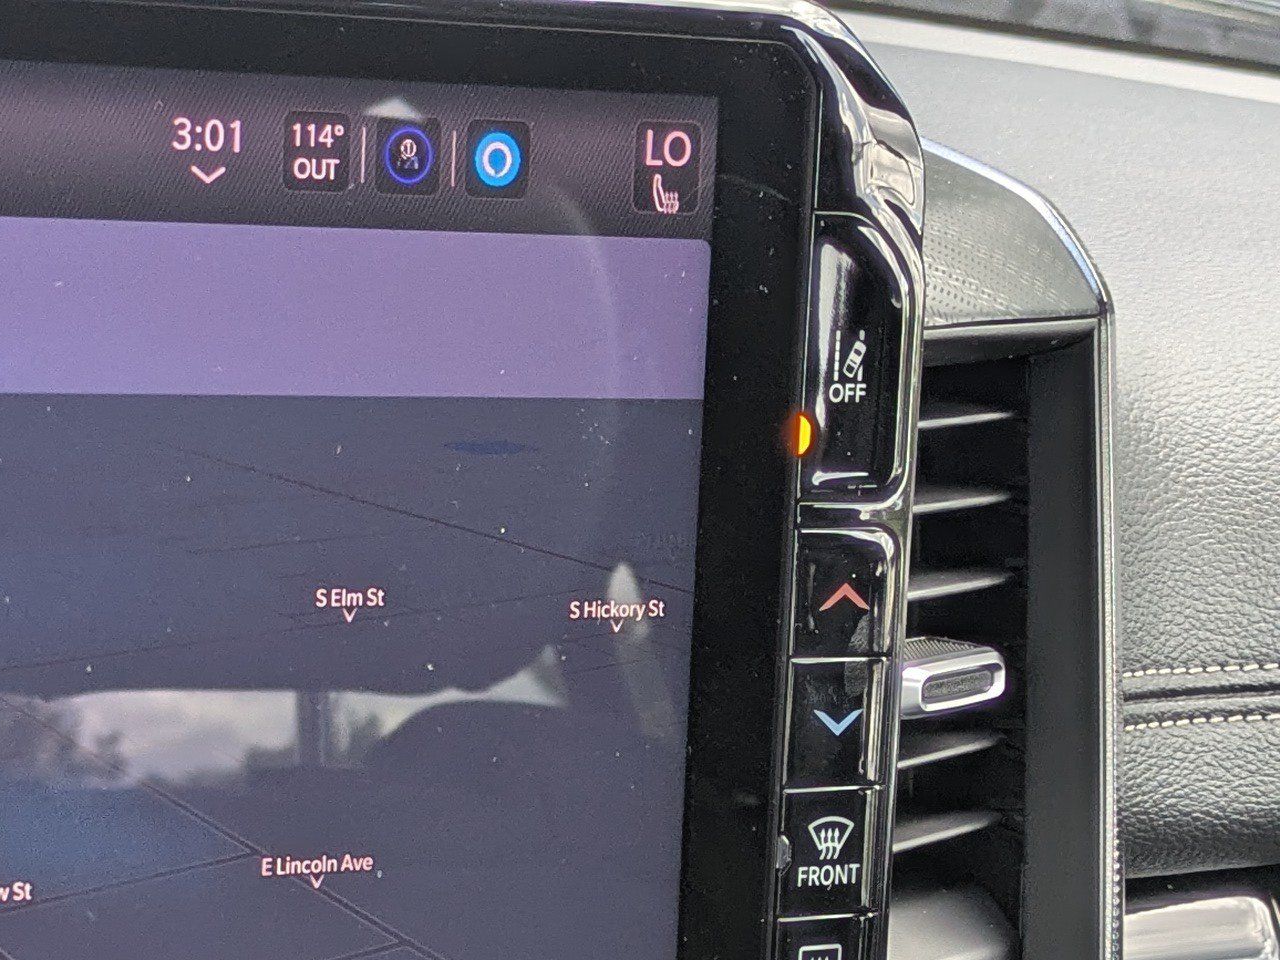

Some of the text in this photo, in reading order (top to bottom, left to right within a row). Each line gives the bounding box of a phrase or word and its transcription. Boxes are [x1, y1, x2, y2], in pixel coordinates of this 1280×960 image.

[172, 117, 243, 153] 3:01
[644, 128, 692, 167] LO
[293, 158, 340, 181] OUT
[828, 382, 868, 404] OFF
[315, 587, 385, 608] S Elm St
[570, 600, 665, 621] S Hickory St
[261, 853, 374, 877] E Lincoln Ave
[796, 863, 861, 887] FRONT
[12, 881, 33, 901] St
